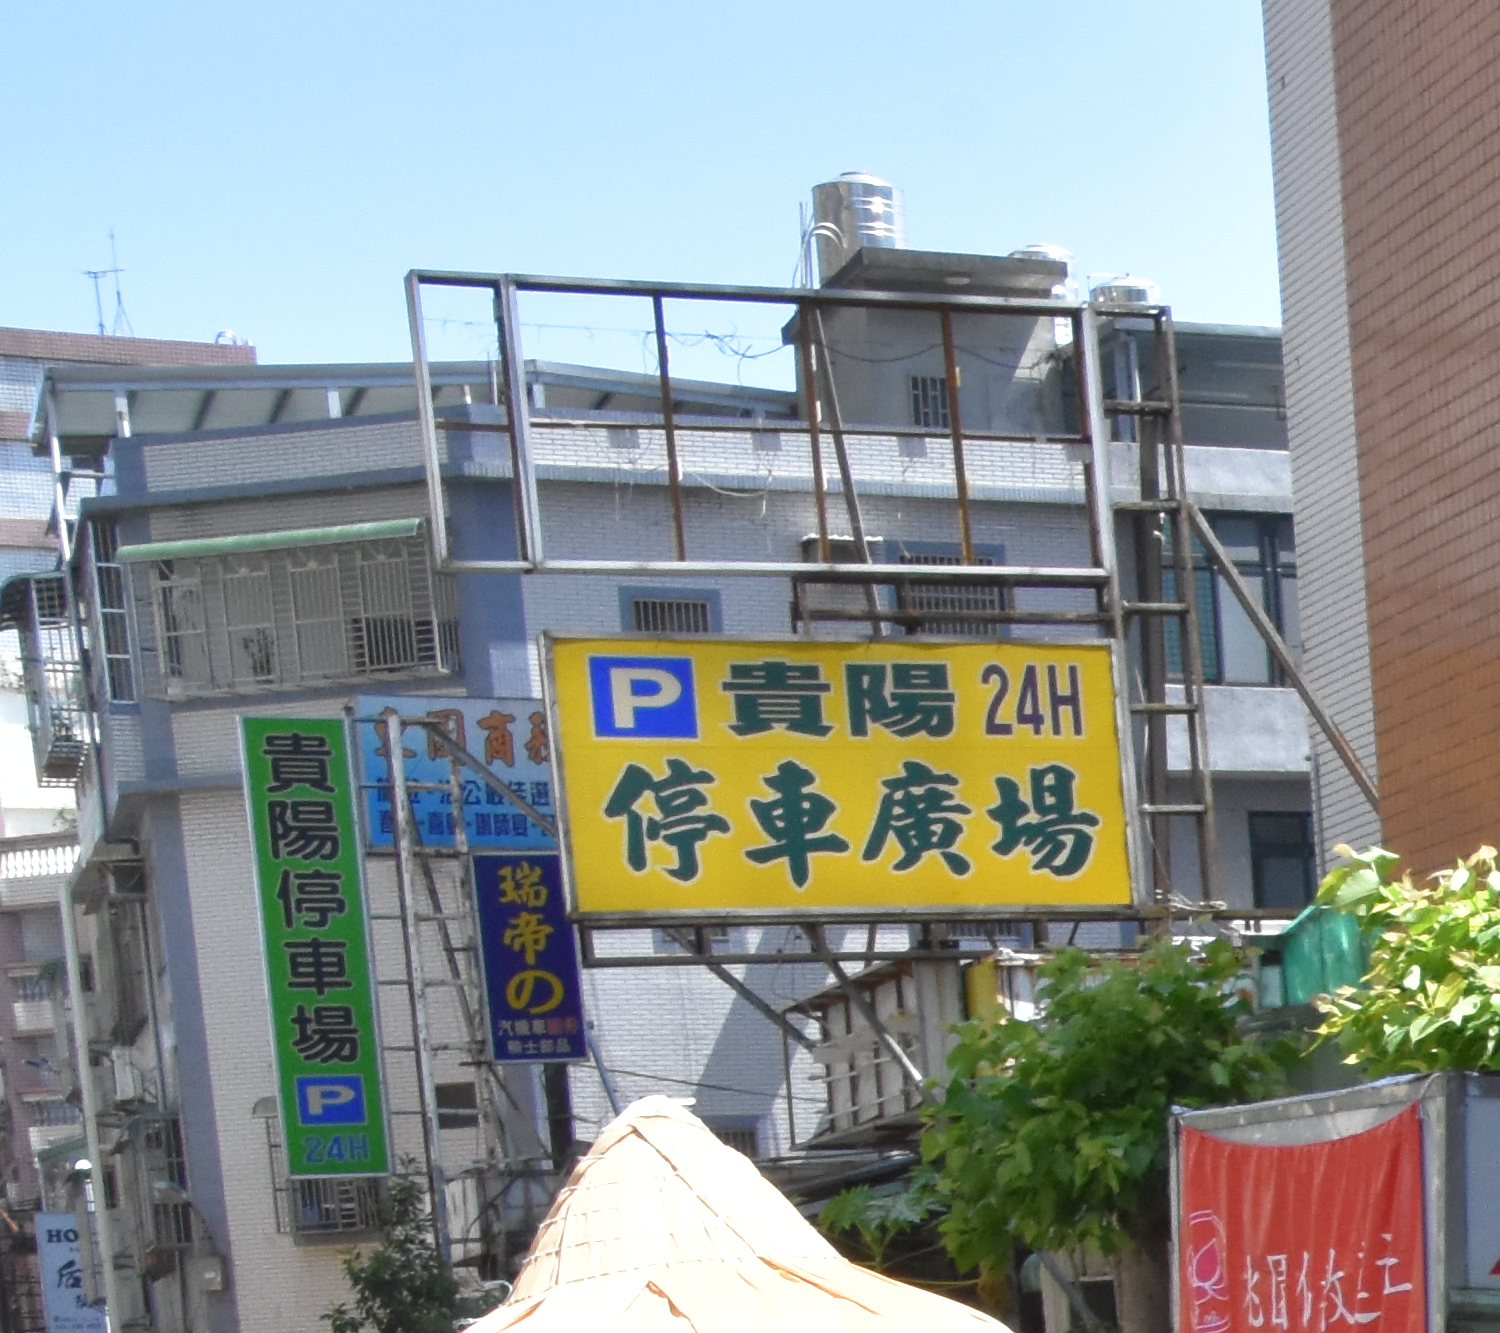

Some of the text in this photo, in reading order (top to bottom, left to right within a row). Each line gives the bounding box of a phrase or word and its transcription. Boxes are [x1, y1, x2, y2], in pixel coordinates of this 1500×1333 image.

[610, 660, 1083, 738] P 貴陽 24H
[602, 757, 1101, 889] 停車廣場
[261, 731, 362, 1065] 貴陽停車場
[496, 860, 566, 1016] 瑞帝の
[303, 1134, 371, 1164] 24H
[305, 1084, 356, 1116] P
